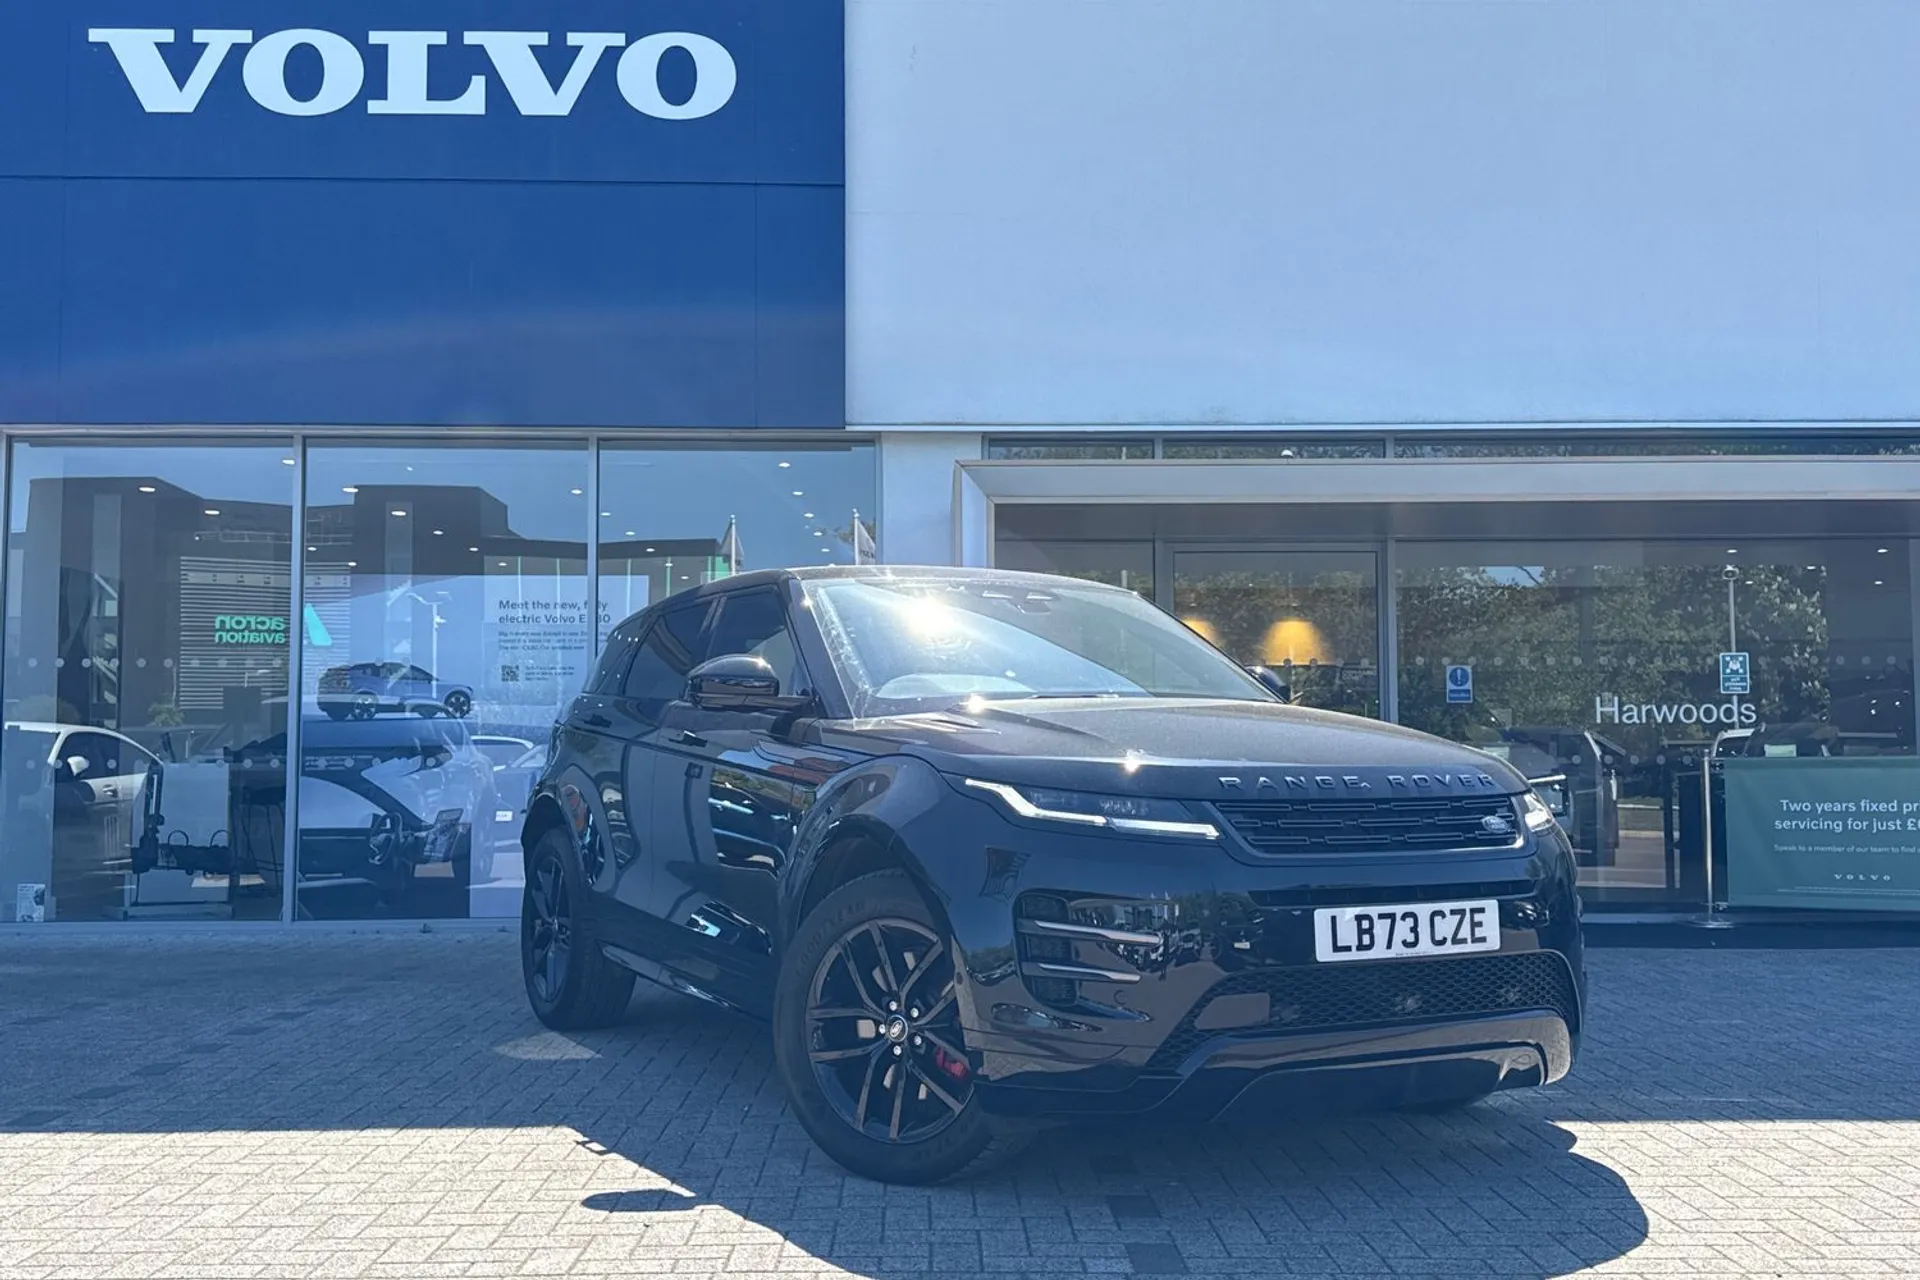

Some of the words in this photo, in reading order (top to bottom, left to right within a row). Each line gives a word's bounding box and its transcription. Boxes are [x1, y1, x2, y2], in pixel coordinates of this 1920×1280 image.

[88, 28, 737, 120] VOLVO
[498, 600, 529, 610] Meet
[532, 600, 551, 610] the
[498, 614, 541, 624] electric
[544, 614, 576, 624] Volvo
[1595, 695, 1757, 724] Harwoods
[1218, 775, 1361, 790] RANGE
[1386, 773, 1496, 789] ROVER
[1780, 799, 1812, 812] Two
[1815, 801, 1857, 815] years
[1860, 799, 1898, 812] fixed
[1774, 817, 1843, 834] servicing
[1847, 817, 1869, 830] for
[1871, 818, 1902, 834] just
[1834, 873, 1891, 881] VOLVO
[1330, 911, 1420, 953] LB73
[1429, 907, 1487, 946] CZE
